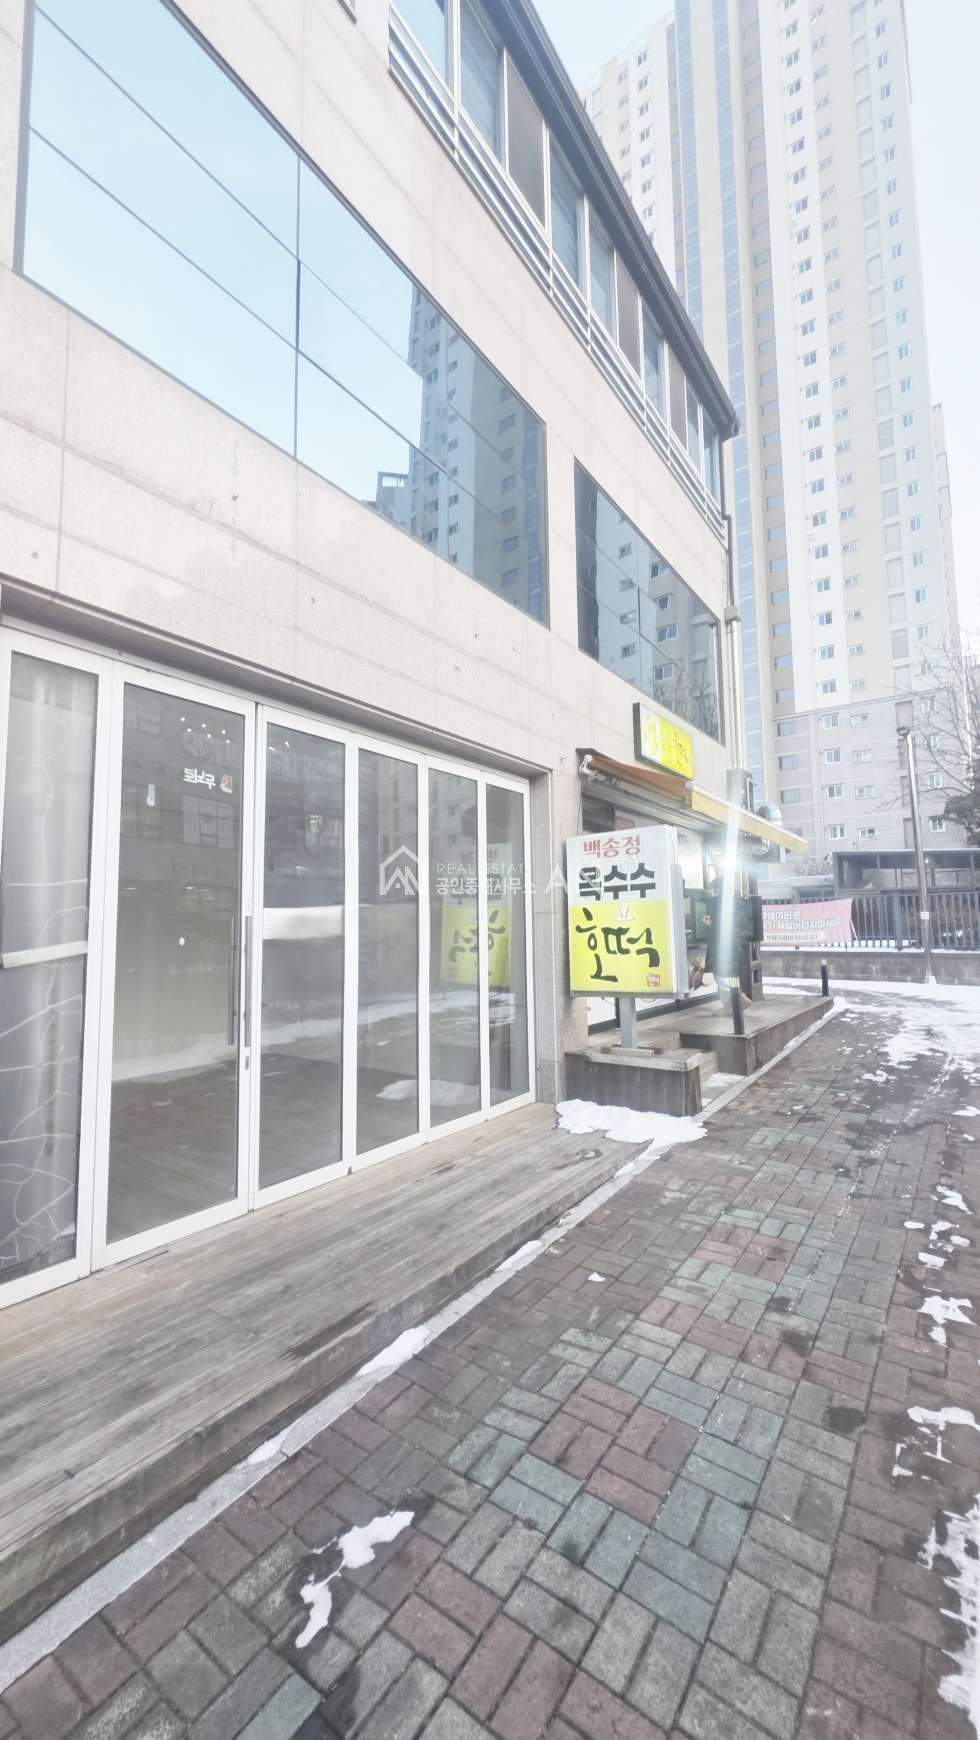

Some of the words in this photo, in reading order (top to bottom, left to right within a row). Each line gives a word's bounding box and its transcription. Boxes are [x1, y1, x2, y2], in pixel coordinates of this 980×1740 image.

[583, 835, 641, 859] 백송정
[578, 862, 656, 901] 옥수수
[575, 907, 661, 983] 호떡
